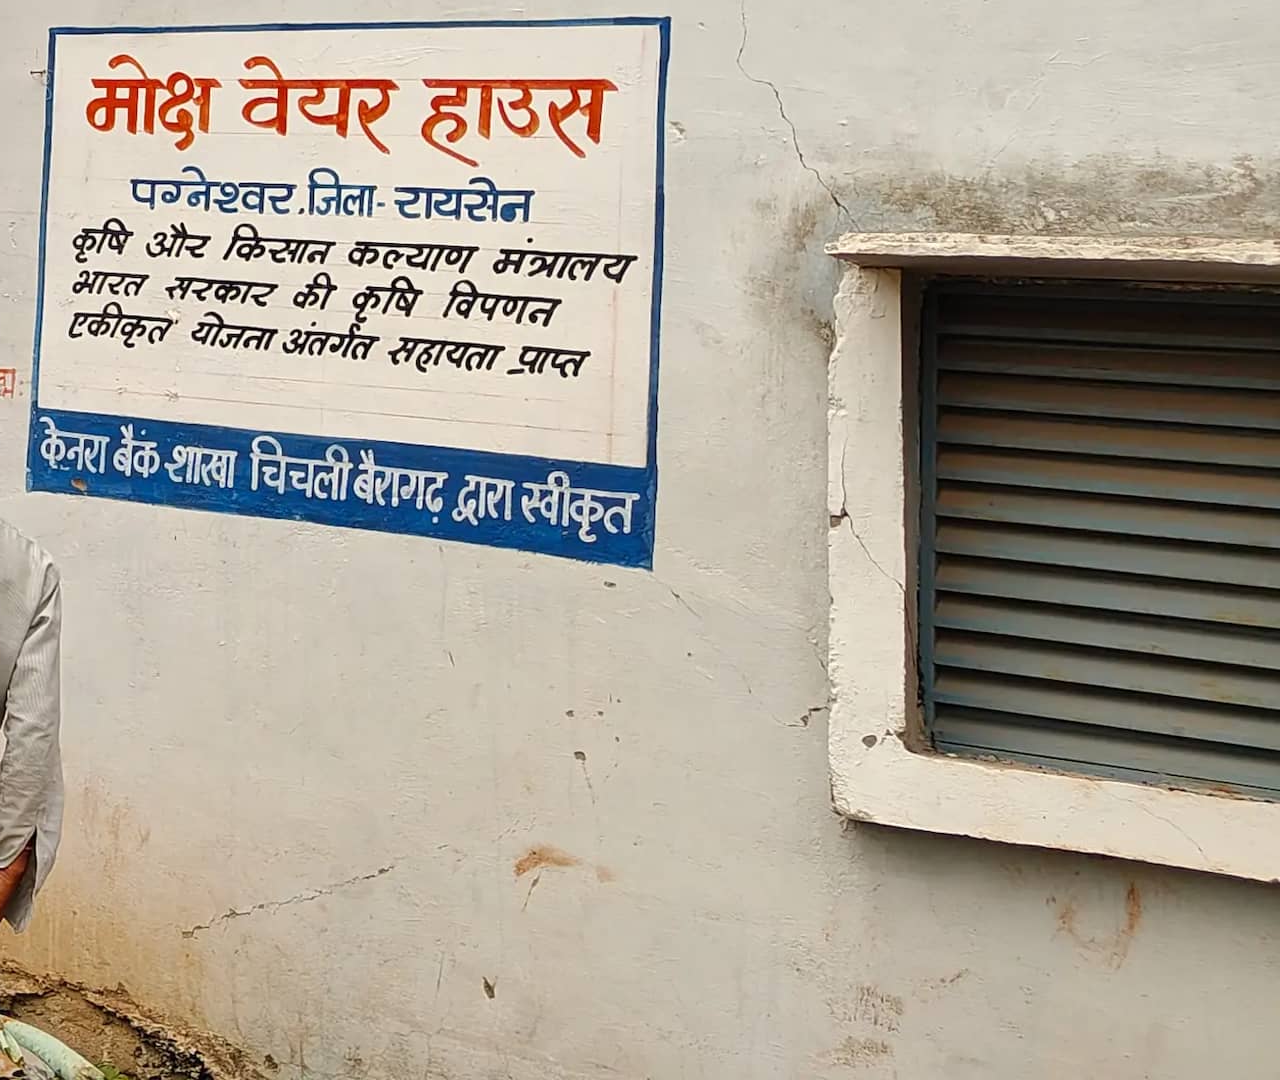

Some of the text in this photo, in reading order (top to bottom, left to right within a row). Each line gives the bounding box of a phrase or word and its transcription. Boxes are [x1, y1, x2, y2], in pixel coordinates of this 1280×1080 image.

[85, 54, 618, 167] मोक्ष वेयर हाउस
[393, 176, 536, 223] रायसेन
[71, 217, 639, 284] कृषि और किसान कल्याण मंत्रालय
[71, 269, 563, 328] भारत सरकार की कृषि विपणन
[67, 301, 592, 378] एकीकृत योजना अंतर्गत सहायता प्राप्त
[39, 416, 641, 543] केनरा बैंक शाखा चिचली बैरागढ़ द्वारा स्वीकृत
